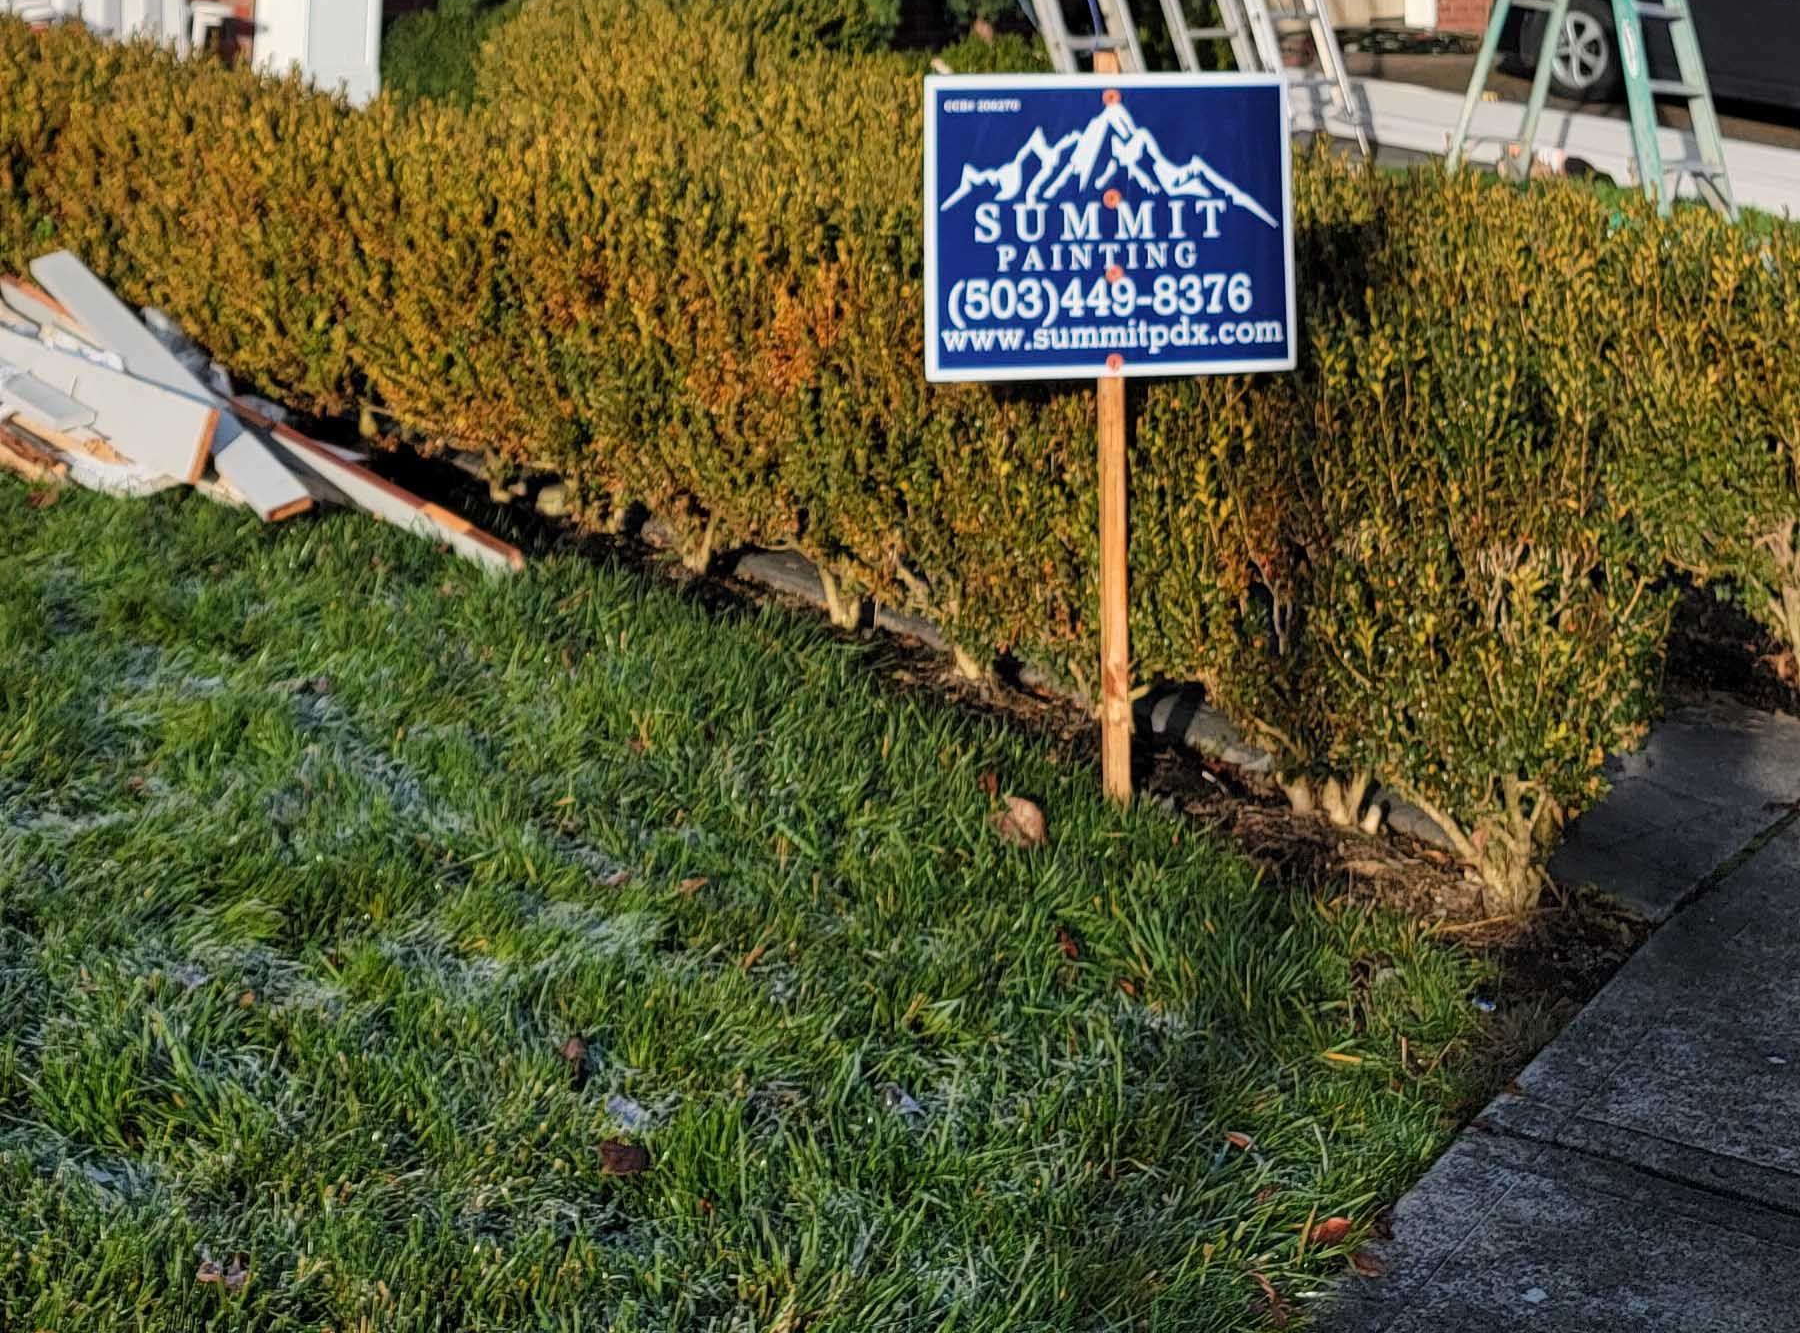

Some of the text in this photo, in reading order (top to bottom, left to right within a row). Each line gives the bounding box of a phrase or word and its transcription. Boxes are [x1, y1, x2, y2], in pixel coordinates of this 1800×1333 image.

[974, 199, 1227, 243] SUMMIT
[996, 241, 1199, 272] PAINTING
[947, 273, 1254, 330] (503)449-8376
[941, 316, 1285, 355] www.summitpdx.com
